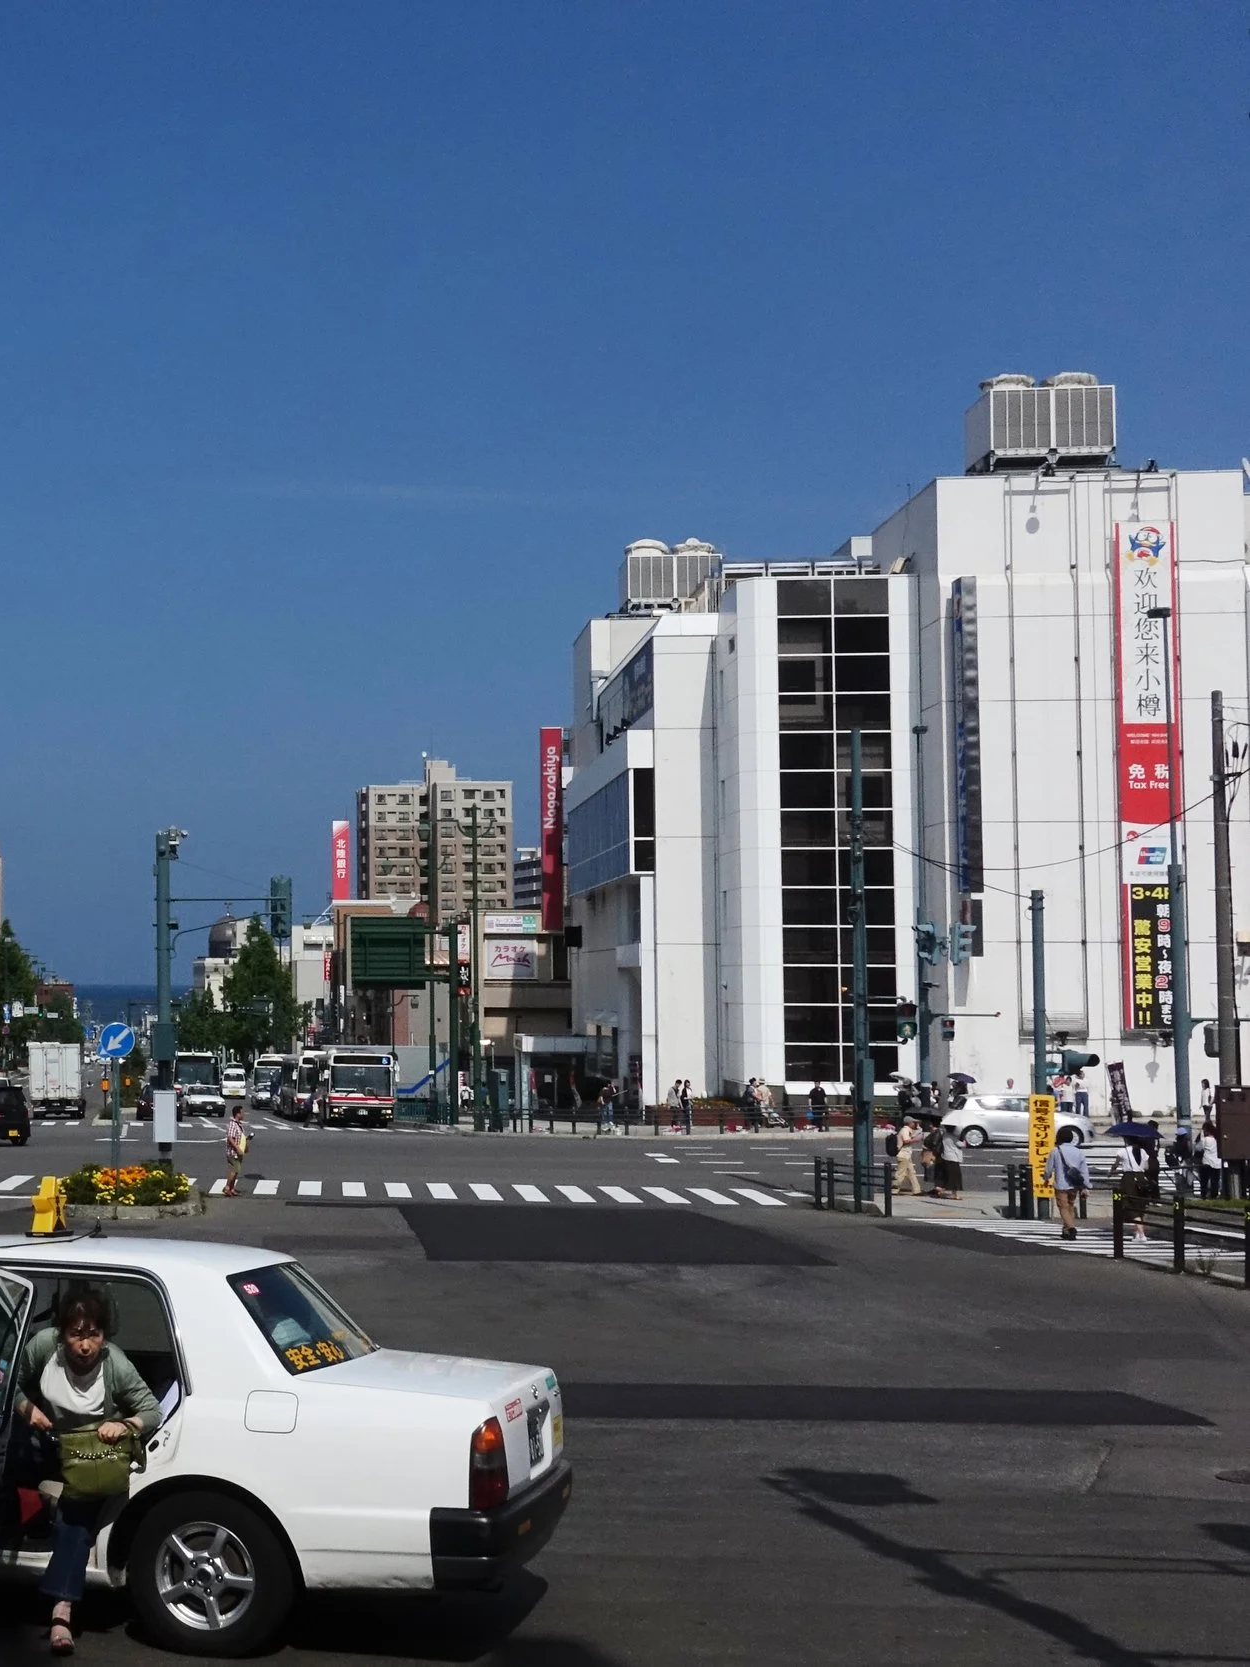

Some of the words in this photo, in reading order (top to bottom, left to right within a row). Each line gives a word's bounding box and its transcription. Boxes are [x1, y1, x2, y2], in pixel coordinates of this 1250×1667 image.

[543, 746, 560, 829] Nagasakiya
[1128, 780, 1147, 789] Tax
[1149, 780, 1169, 789] Free
[494, 945, 527, 953] カラオケ
